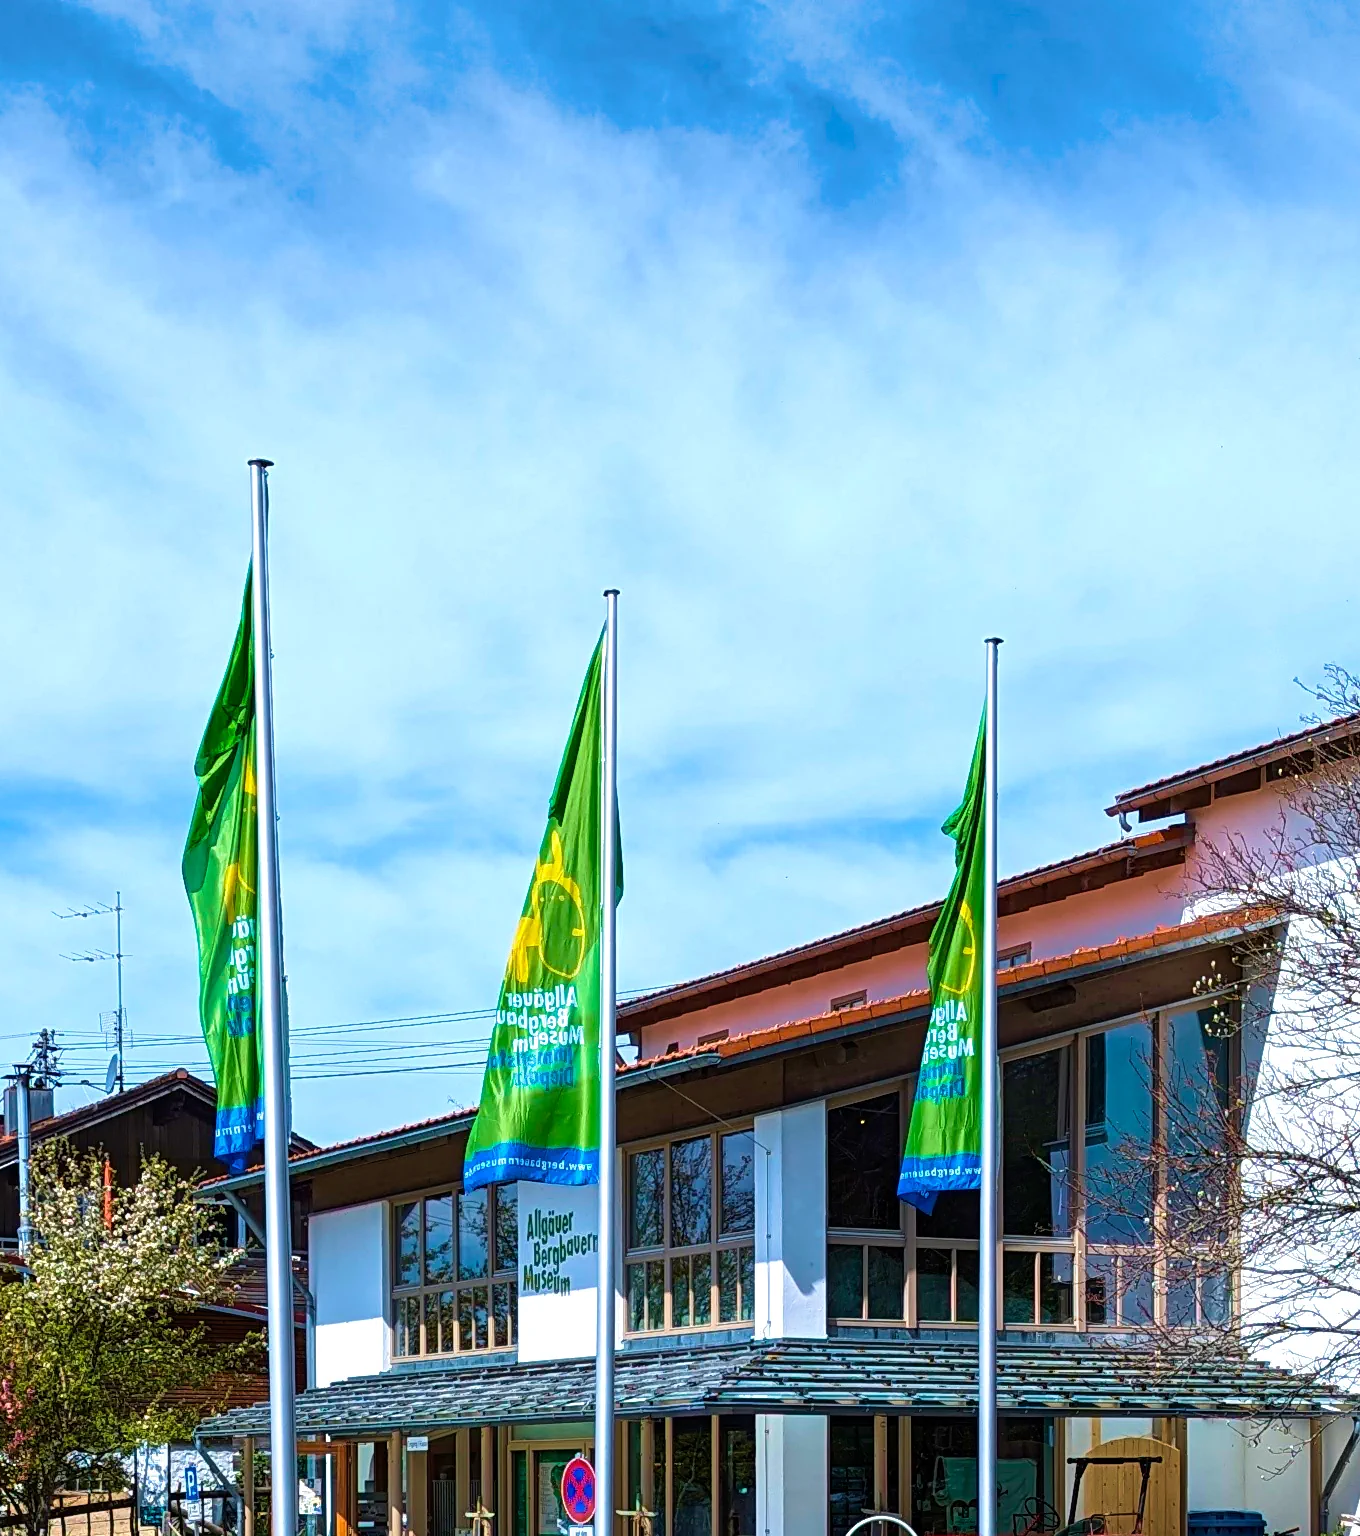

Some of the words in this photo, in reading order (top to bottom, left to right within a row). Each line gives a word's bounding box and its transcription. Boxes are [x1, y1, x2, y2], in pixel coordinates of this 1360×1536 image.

[527, 1208, 574, 1245] Allgäuer
[533, 1232, 598, 1275] Bergbauern
[523, 1264, 571, 1297] Museum
[187, 1471, 195, 1497] P
